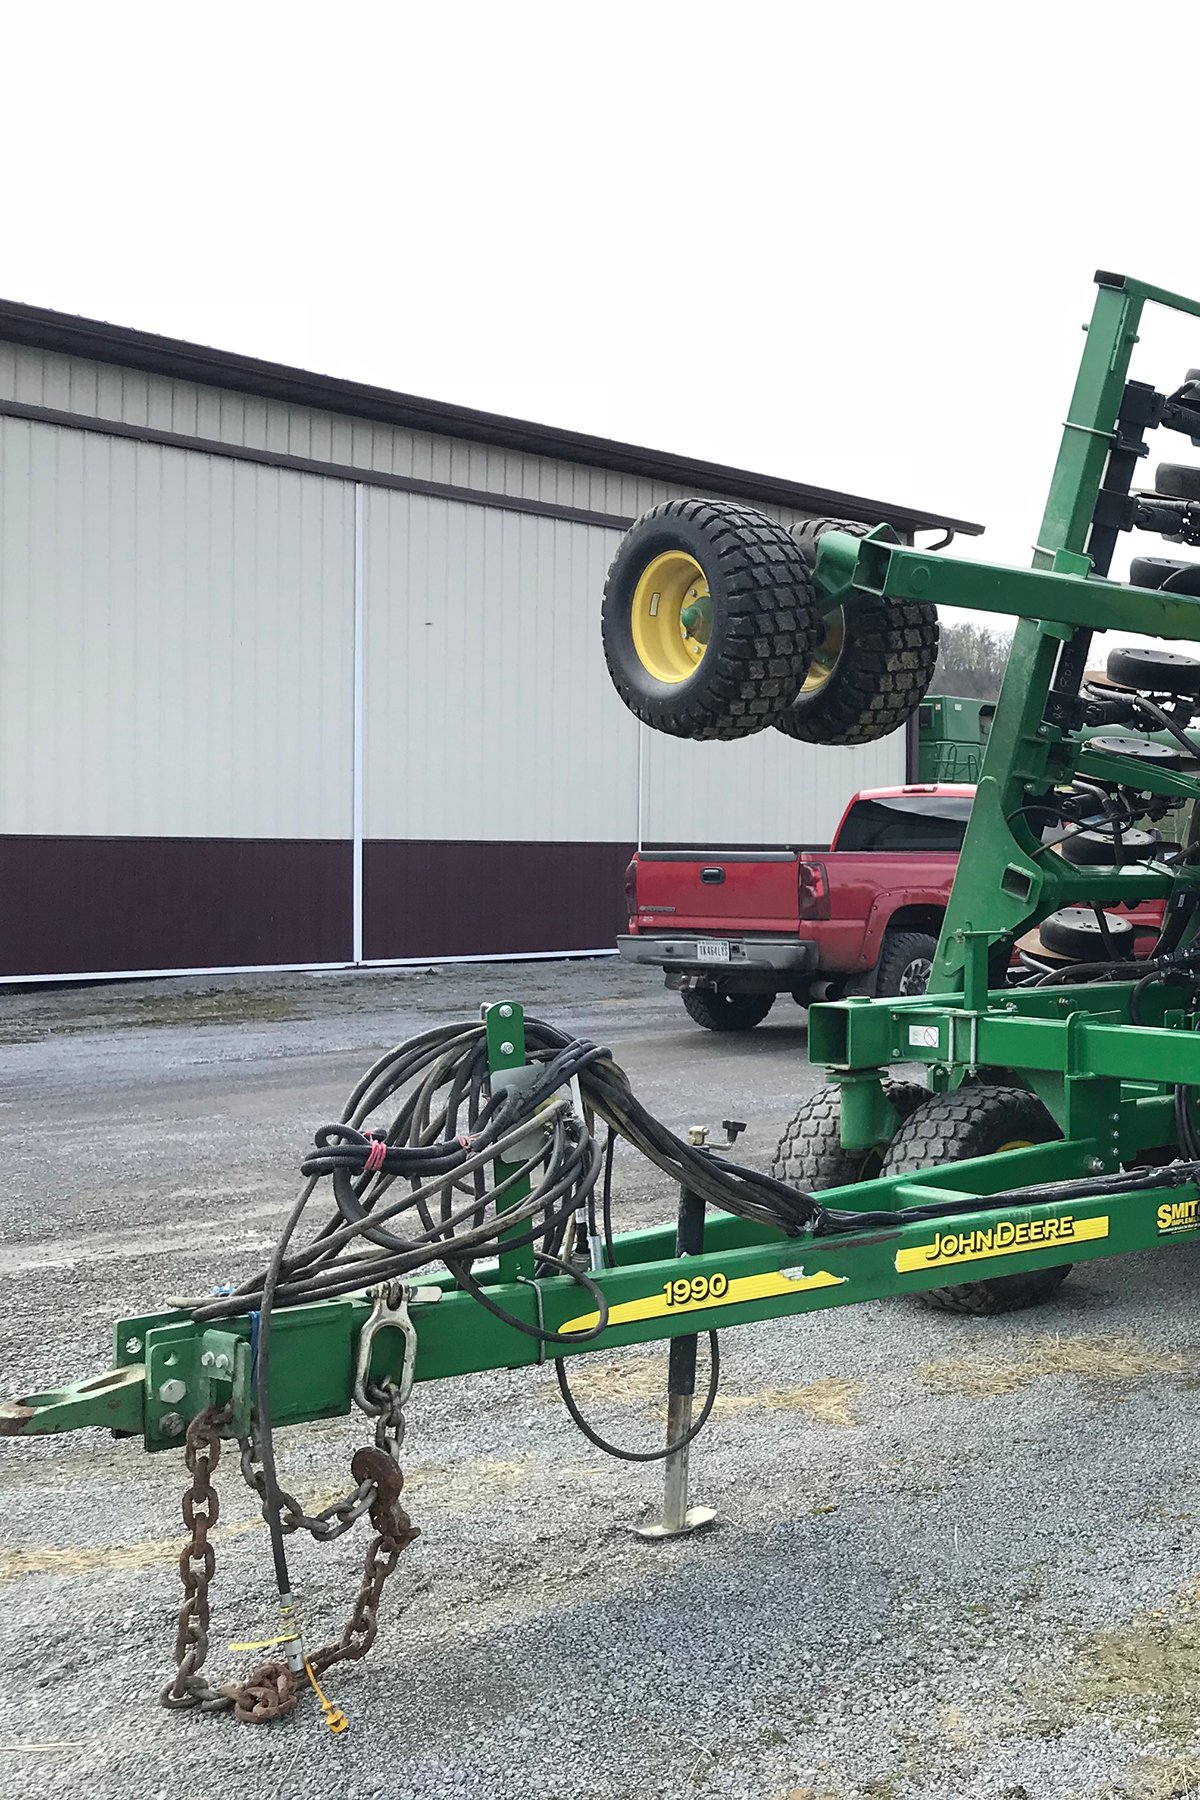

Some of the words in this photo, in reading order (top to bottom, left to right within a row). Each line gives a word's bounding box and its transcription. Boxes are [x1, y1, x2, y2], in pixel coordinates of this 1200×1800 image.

[1157, 1200, 1200, 1229] SMIT
[925, 1229, 993, 1260] JOHN
[995, 1215, 1074, 1248] DEERE
[663, 1272, 729, 1307] 1990
